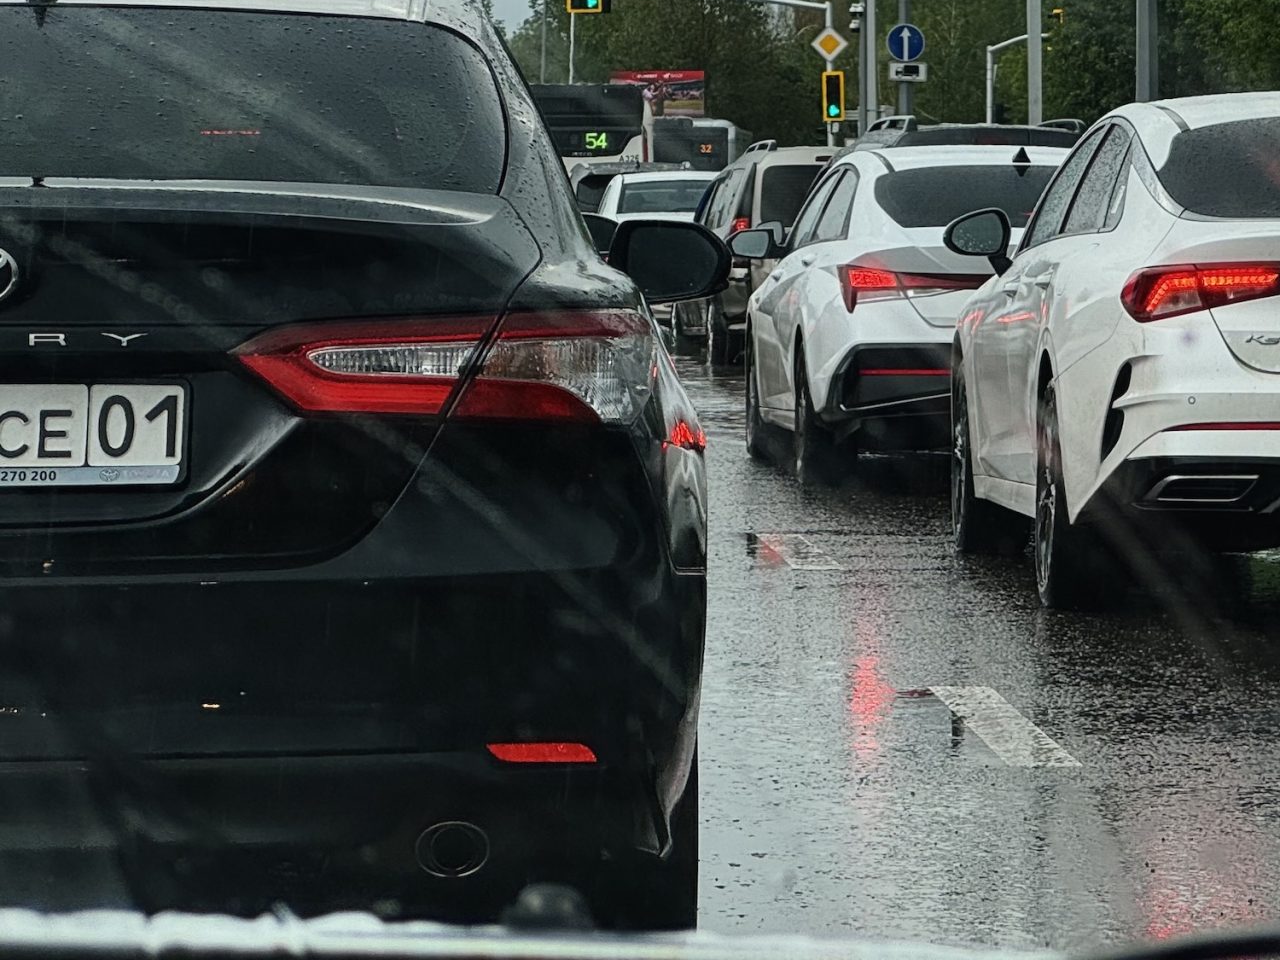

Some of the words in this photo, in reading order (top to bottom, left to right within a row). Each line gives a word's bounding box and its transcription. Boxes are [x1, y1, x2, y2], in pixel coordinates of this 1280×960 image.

[585, 132, 607, 149] 54
[700, 143, 712, 153] 32
[0, 409, 73, 459] CE
[98, 394, 178, 458] 01
[1, 470, 26, 482] 270
[31, 470, 57, 482] 200
